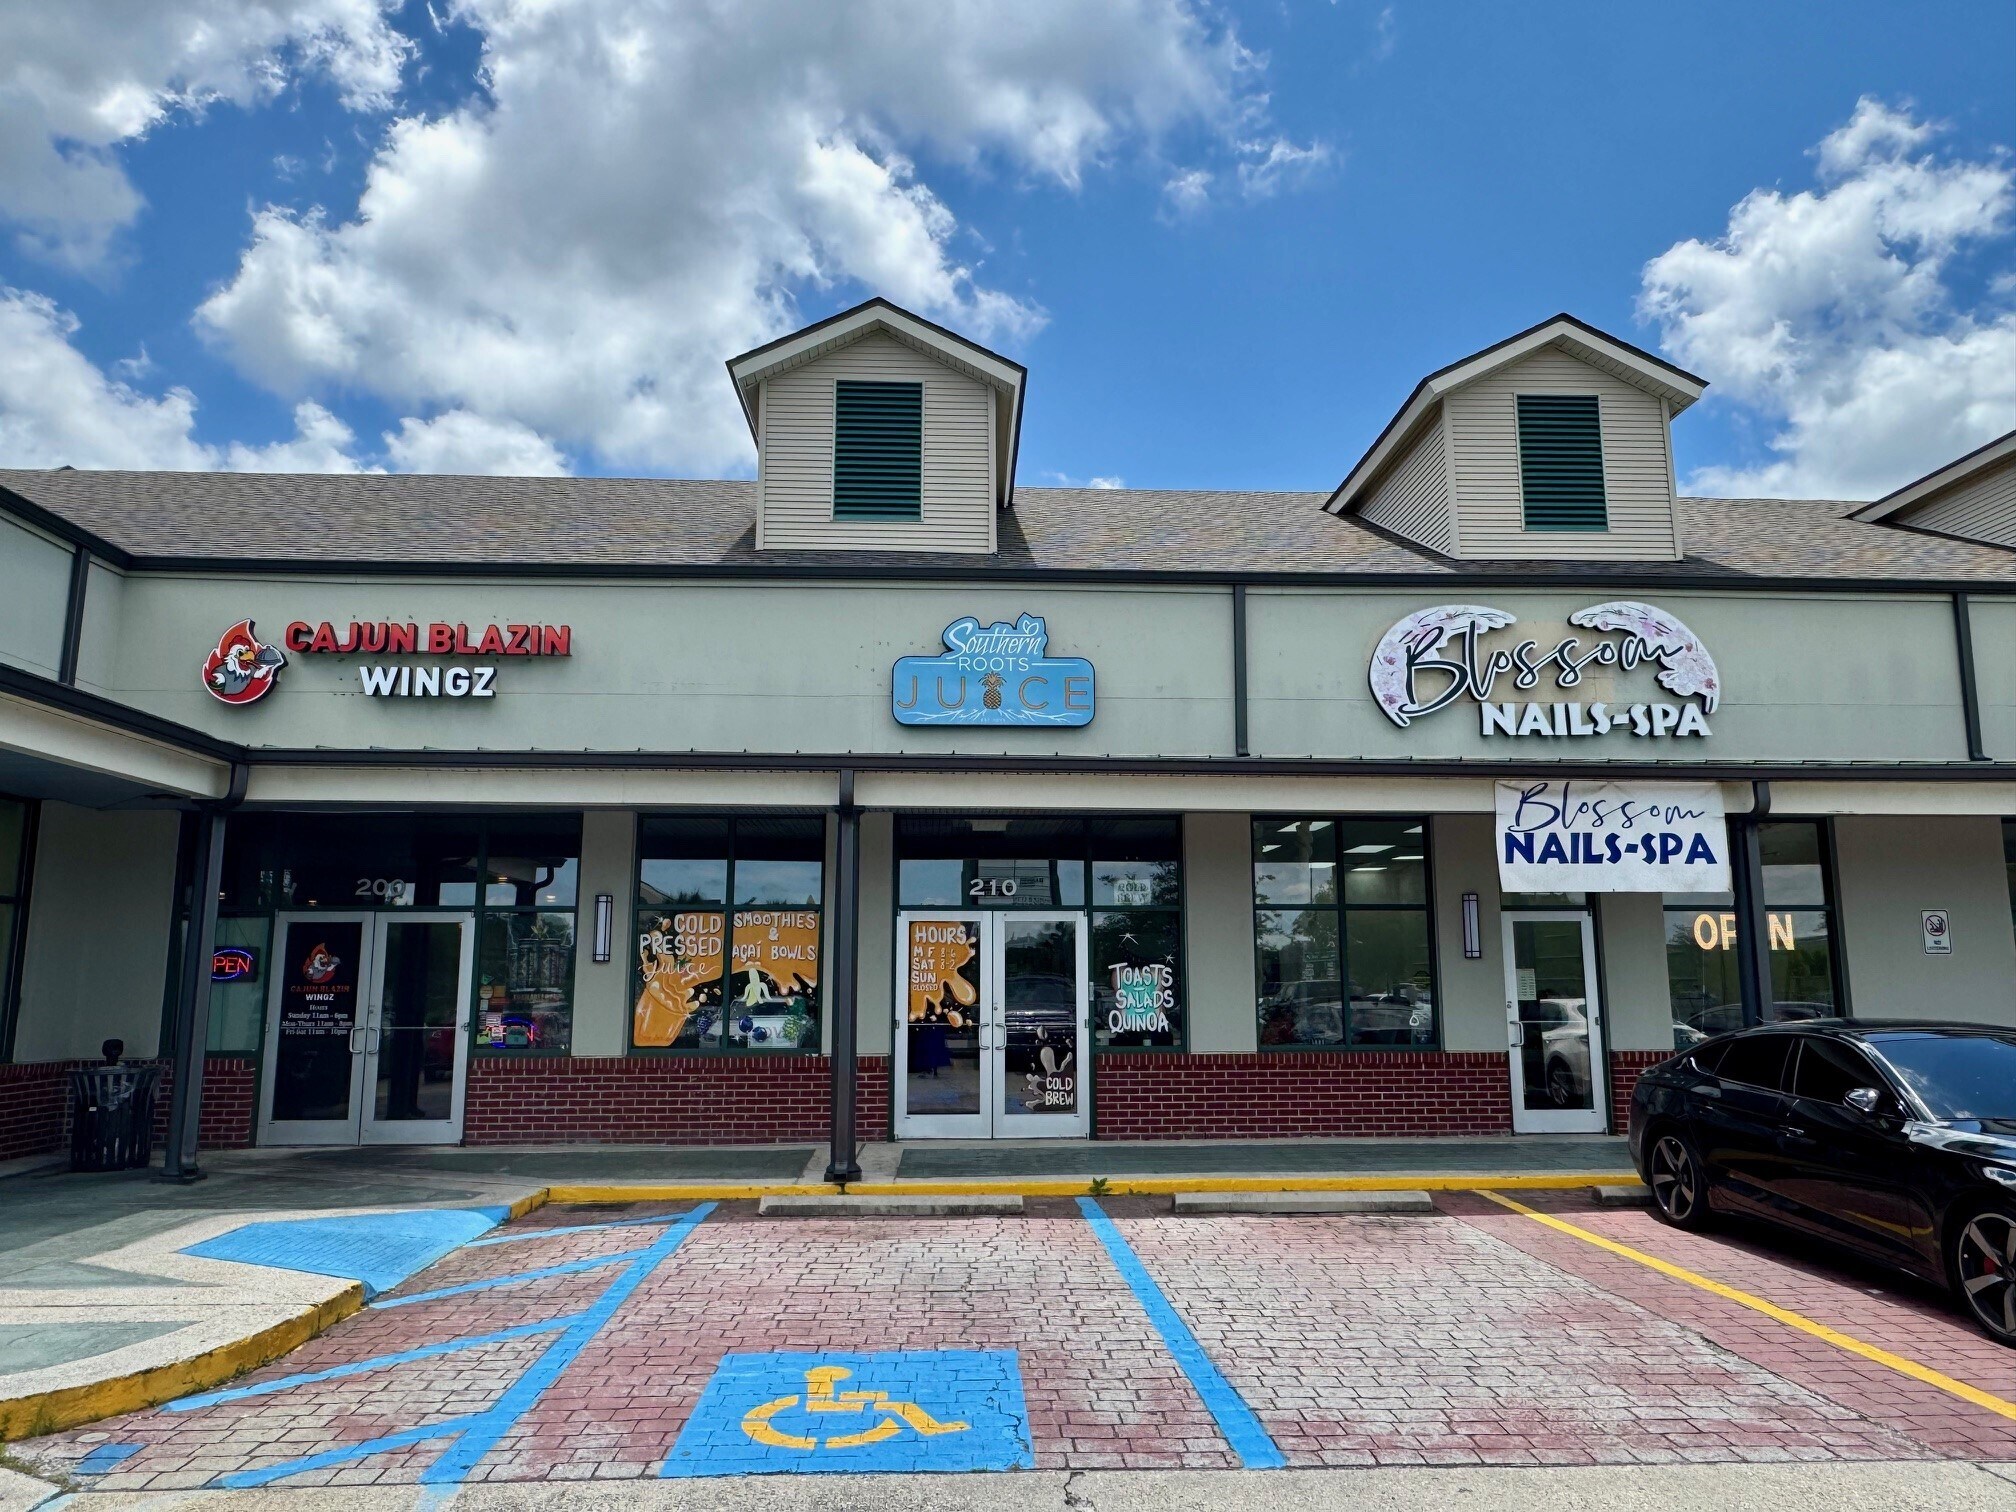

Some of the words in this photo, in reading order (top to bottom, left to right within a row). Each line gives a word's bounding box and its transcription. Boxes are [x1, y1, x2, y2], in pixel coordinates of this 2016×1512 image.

[285, 621, 418, 654] CAJUN
[428, 622, 572, 656] BLAZIN
[946, 621, 1043, 660] Southern
[958, 657, 1029, 671] ROOTS
[1398, 620, 1685, 717] Blossom
[359, 666, 498, 698] WINGZ
[1479, 702, 1713, 737] NAILS-SPA
[1507, 781, 1706, 832] Blossom
[1504, 832, 1718, 865] NAILS-SPA
[355, 878, 406, 896] 200
[969, 878, 1018, 896] 210
[674, 914, 722, 934] COLD
[734, 913, 816, 930] SMOOTHIES
[768, 927, 779, 942] &
[915, 925, 967, 945] HOURS
[1693, 913, 1795, 951] OPN
[639, 933, 722, 957] PRESSED
[771, 945, 817, 961] BOWLS
[213, 956, 250, 973] PEN
[912, 957, 936, 970] SAT
[911, 970, 936, 983] SUN
[1108, 962, 1174, 989] TOASTS
[305, 993, 335, 1001] WINGZ
[1115, 989, 1175, 1009] SALADS
[1108, 1009, 1169, 1033] QUINOA
[1046, 1076, 1073, 1090] COLD
[1045, 1091, 1074, 1105] BREW
